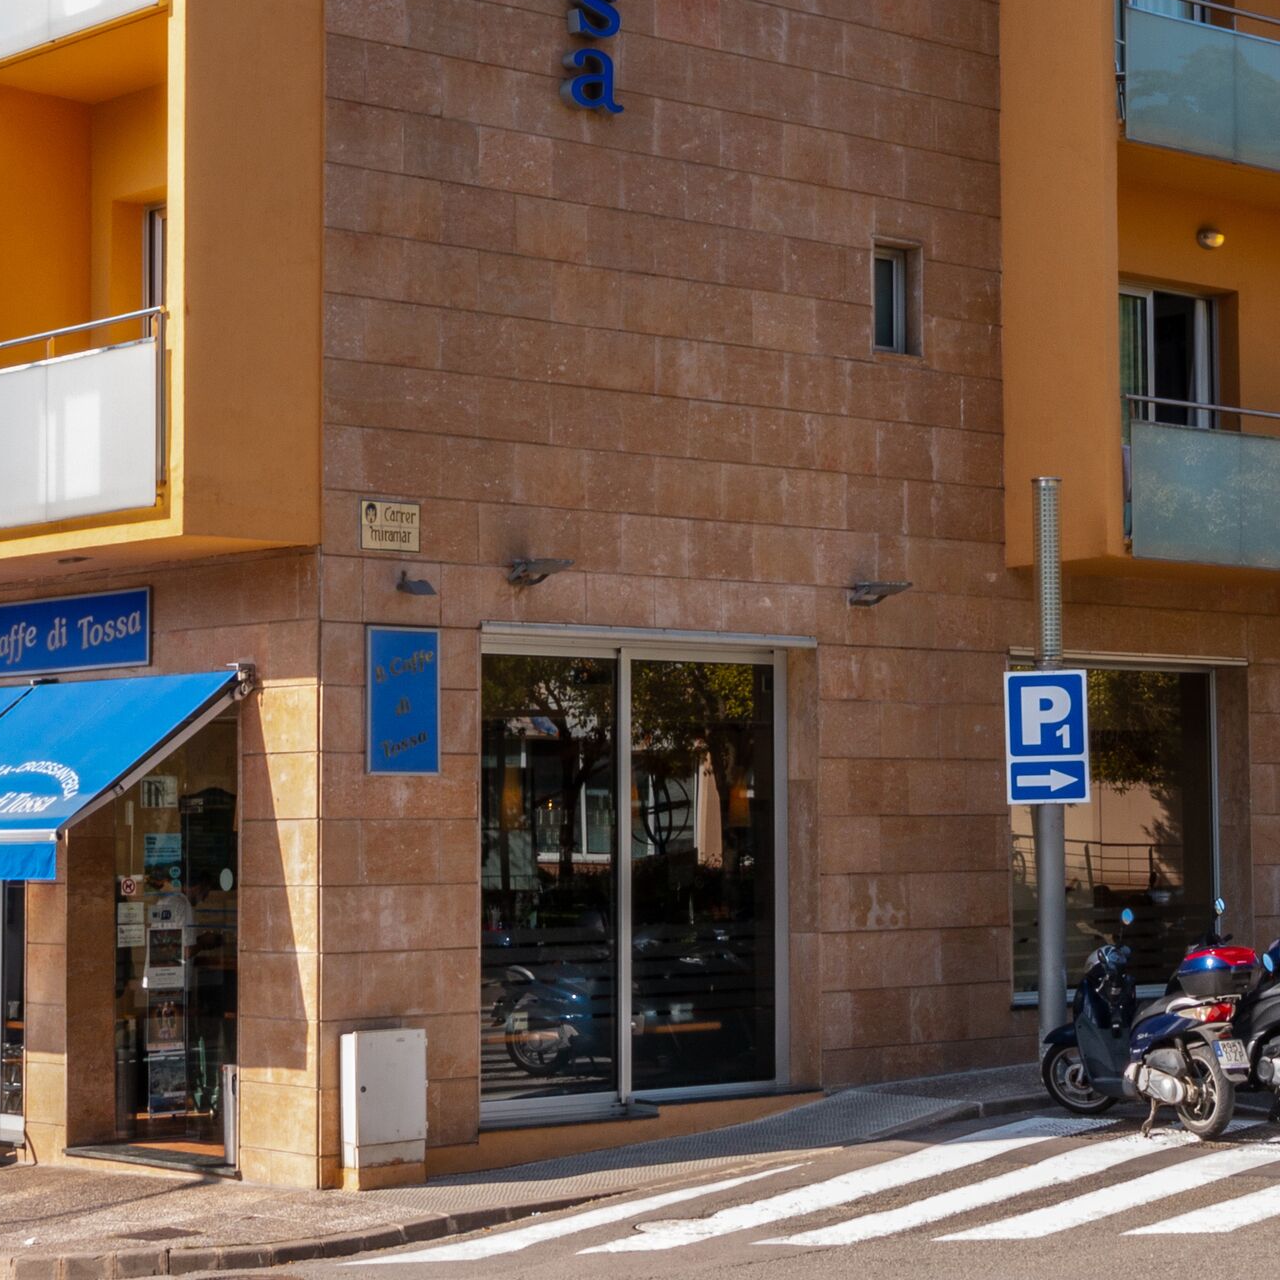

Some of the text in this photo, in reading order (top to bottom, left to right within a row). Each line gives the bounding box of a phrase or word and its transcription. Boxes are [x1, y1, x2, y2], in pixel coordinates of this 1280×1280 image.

[384, 506, 417, 524] Carrer
[47, 617, 69, 651] di
[77, 610, 142, 650] Tossa
[382, 730, 428, 758] Tossa
